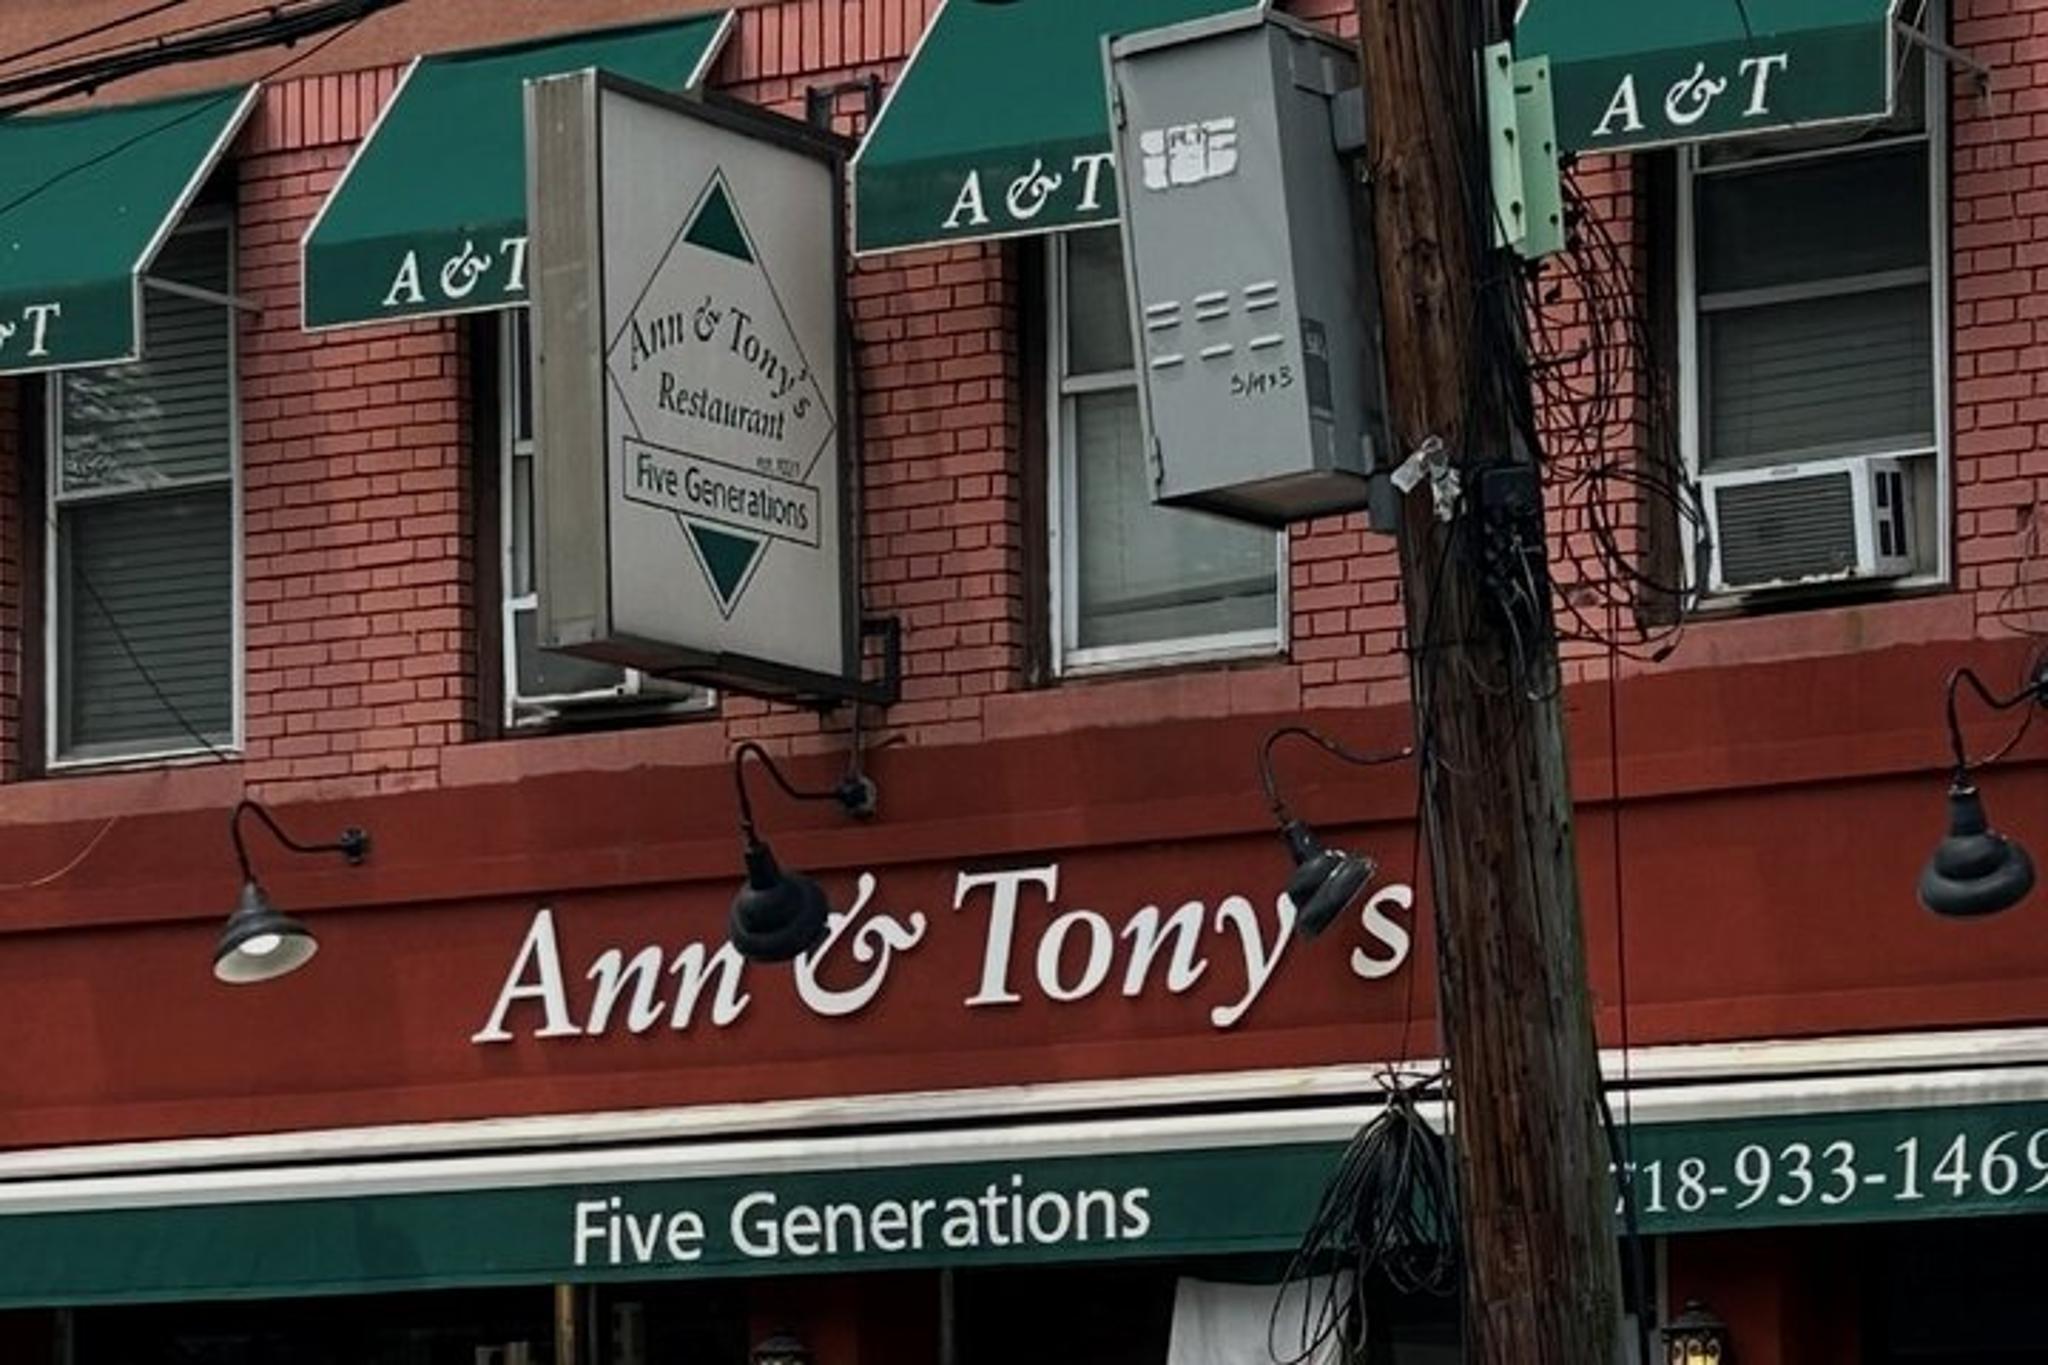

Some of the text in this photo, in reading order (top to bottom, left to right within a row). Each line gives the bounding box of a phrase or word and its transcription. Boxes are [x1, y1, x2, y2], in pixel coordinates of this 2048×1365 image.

[1591, 52, 1788, 137] A & T
[941, 152, 1116, 229] A & T
[382, 235, 529, 306] A & T
[23, 301, 61, 357] T
[630, 295, 812, 419] Ann & Tony's
[657, 371, 785, 441] Restaurant
[636, 453, 679, 497] Five
[684, 466, 809, 531] Generations
[471, 863, 1413, 1044] Ann & Tonys
[573, 1174, 1151, 1266] Five Generations
